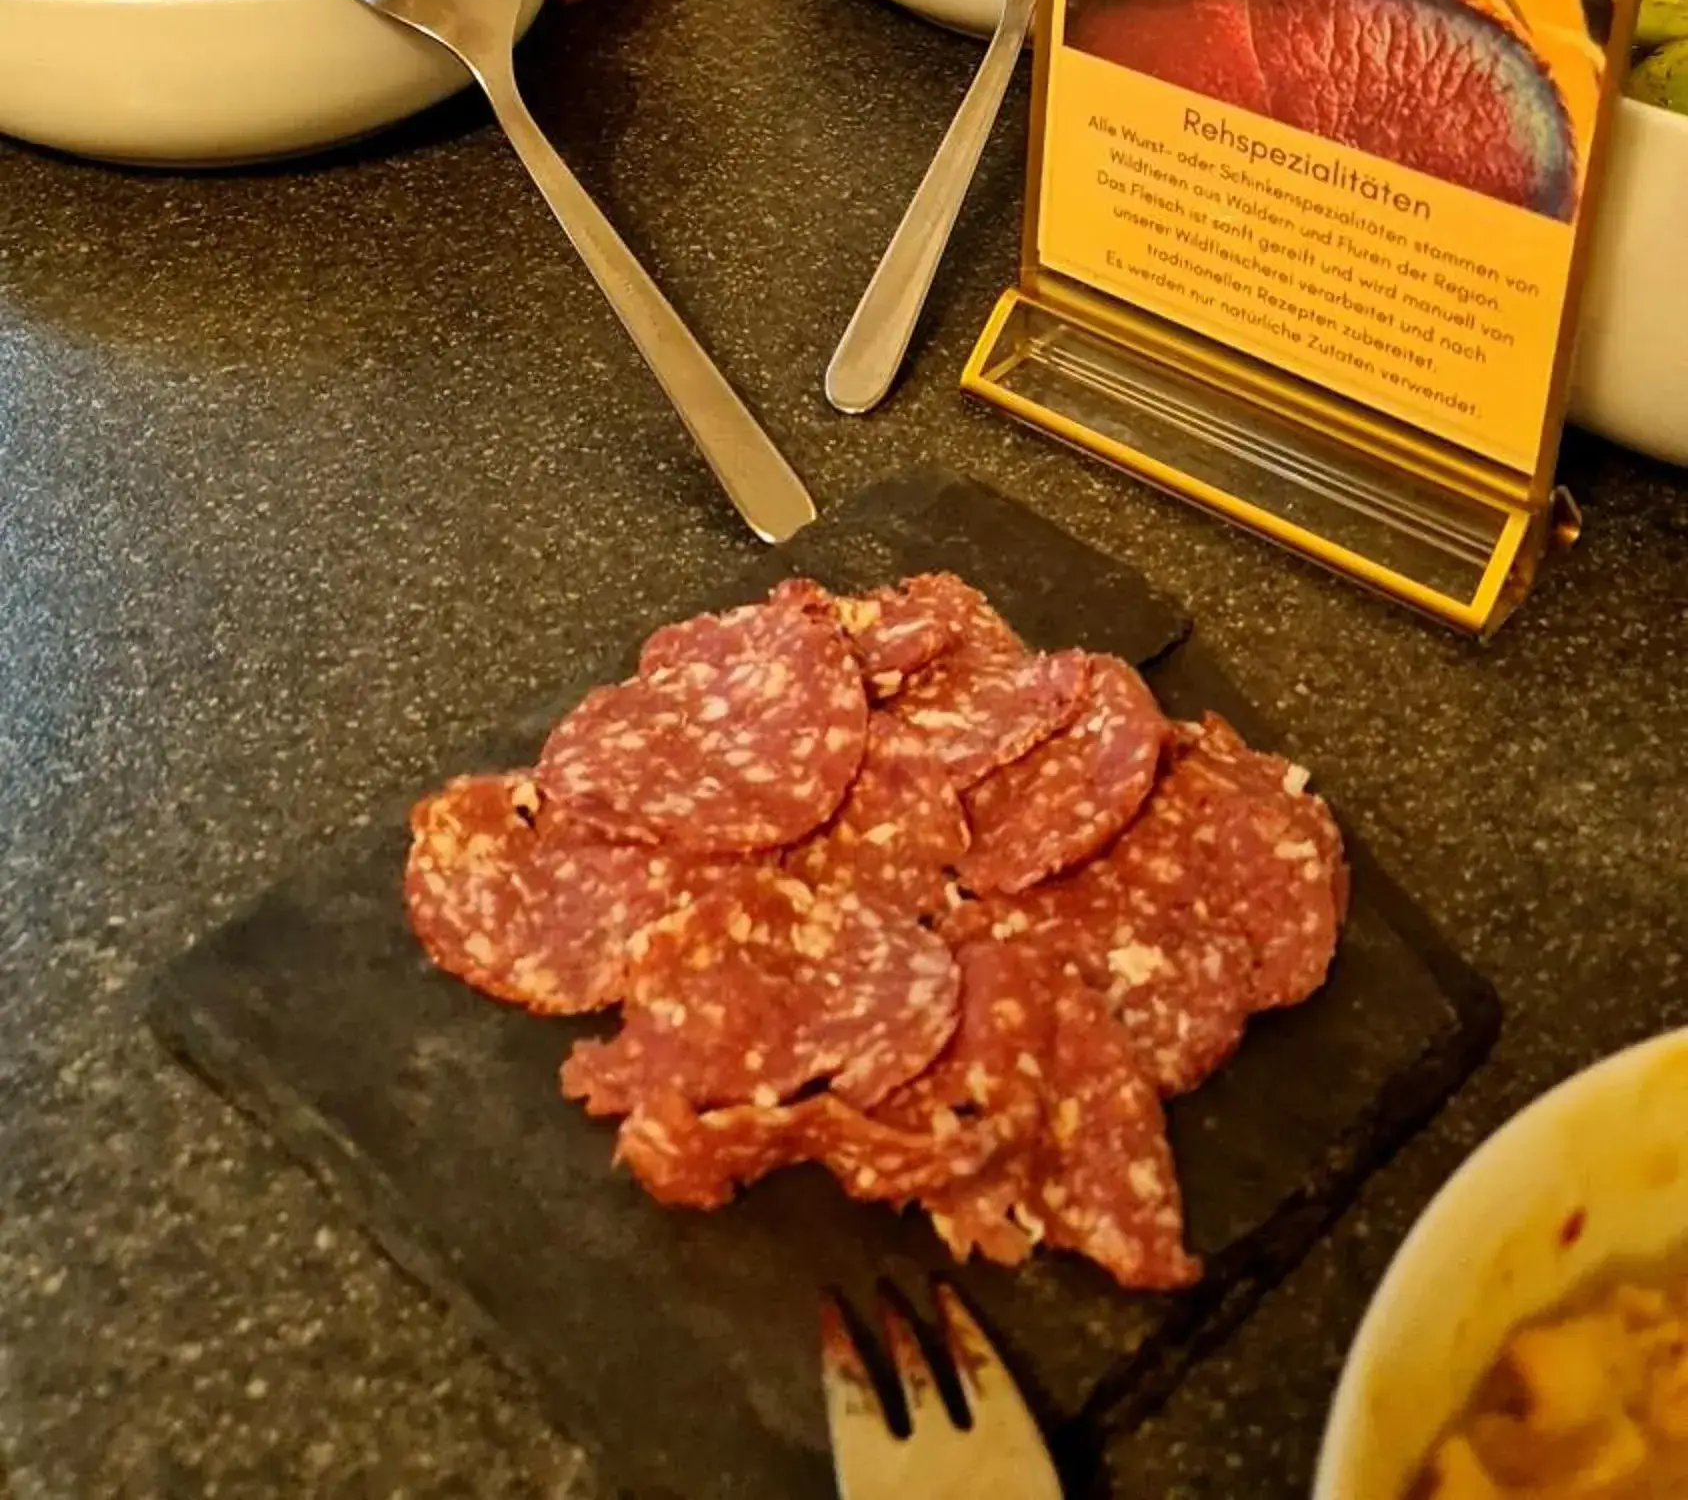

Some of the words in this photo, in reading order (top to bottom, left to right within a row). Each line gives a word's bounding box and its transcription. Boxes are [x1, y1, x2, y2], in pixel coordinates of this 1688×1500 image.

[1088, 114, 1117, 137] Alle
[1121, 125, 1173, 156] Wurst-
[1177, 151, 1216, 173] oder
[1218, 162, 1408, 247] Schinkenspezialitäten
[1413, 239, 1500, 283] stammen
[1505, 274, 1540, 298] von
[1109, 147, 1189, 191] Wildtieren
[1192, 183, 1222, 203] aus
[1300, 223, 1333, 246] und
[1337, 233, 1392, 269] Fluren
[1395, 260, 1428, 283] der
[1183, 106, 1431, 221] Rehspezialitäten
[1096, 168, 1127, 194] Das
[1130, 182, 1186, 216] Fleisch
[1188, 208, 1209, 225] ist
[1212, 216, 1254, 243] sanft
[1258, 235, 1316, 268] gereift
[1320, 259, 1354, 283] und
[1358, 274, 1399, 300] wird
[1402, 291, 1476, 330] manuell
[1480, 321, 1516, 348] von
[1104, 249, 1124, 270] Es
[1127, 260, 1186, 296] werden
[1190, 288, 1215, 307] nur
[1219, 299, 1302, 343] natürliche
[1306, 333, 1375, 374] Zutaten
[1112, 205, 1172, 236] unserer
[1175, 226, 1295, 287] Wildfleischerei
[1298, 278, 1395, 327] verarbeitet
[1399, 319, 1436, 343] und
[1439, 334, 1488, 364] nach
[1147, 242, 1253, 296] traditionellen
[1256, 285, 1338, 332] Rezepten
[1342, 324, 1438, 373] zubereitet.
